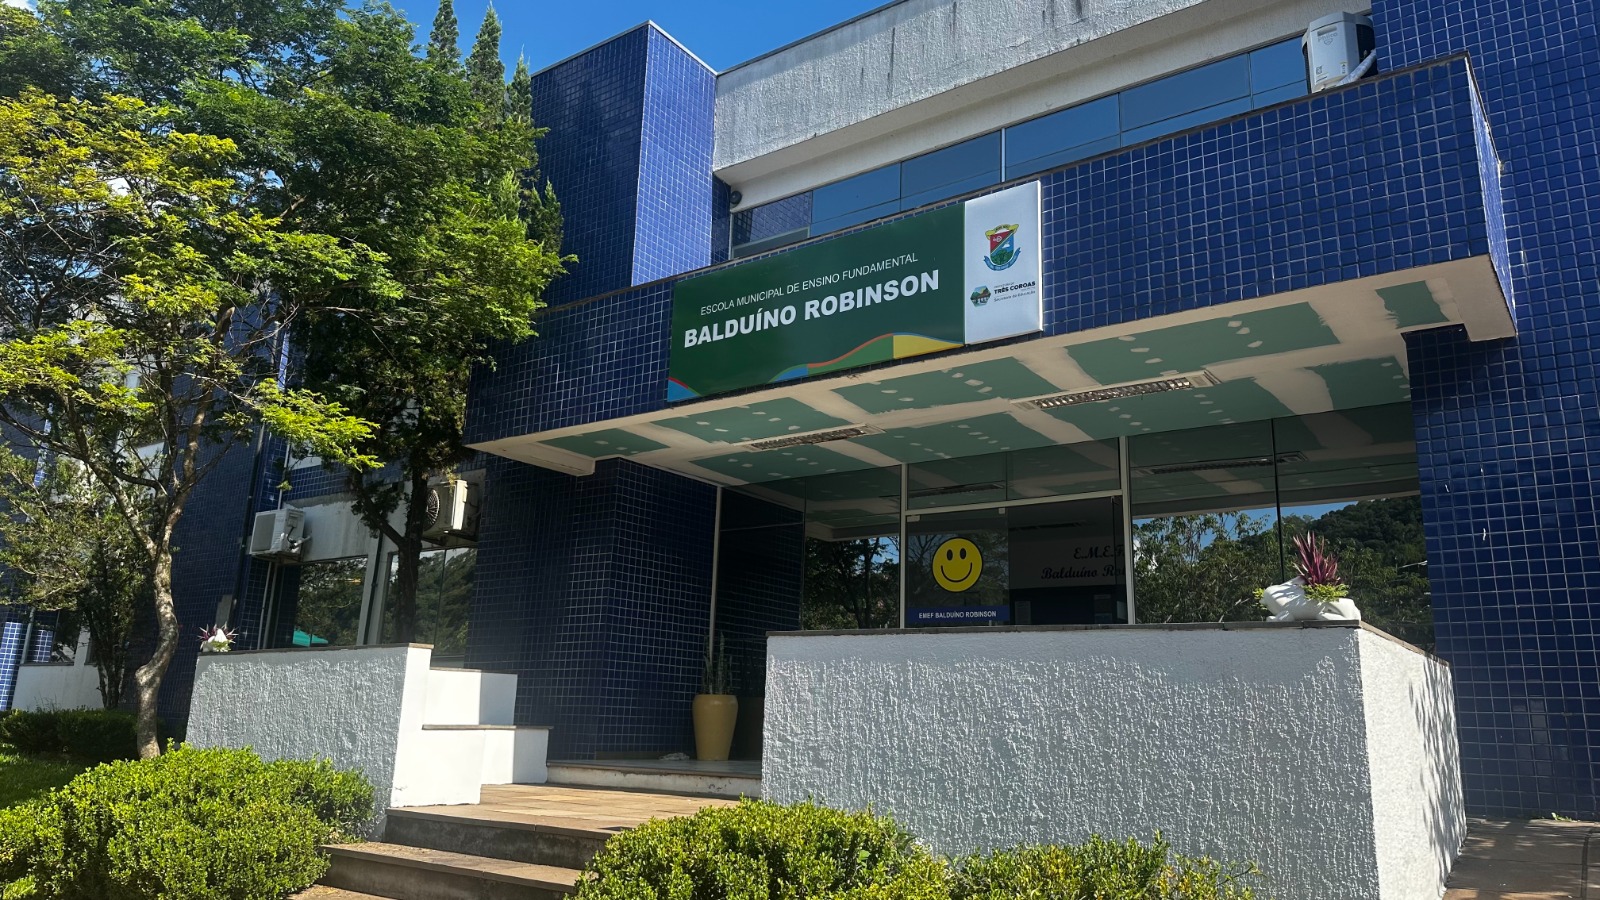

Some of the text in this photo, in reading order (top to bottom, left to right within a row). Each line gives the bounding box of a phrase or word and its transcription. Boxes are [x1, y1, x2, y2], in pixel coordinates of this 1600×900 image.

[701, 252, 919, 316] ESCOLA MUNICIPAL DE ENSINO FUNDAMENTAL
[1010, 281, 1036, 291] COROAS
[684, 269, 939, 348] BALDUÍNO ROBINSON
[1041, 566, 1098, 579] Balduíno
[935, 611, 964, 619] BALDUÍNO
[965, 610, 997, 618] ROBINSON
